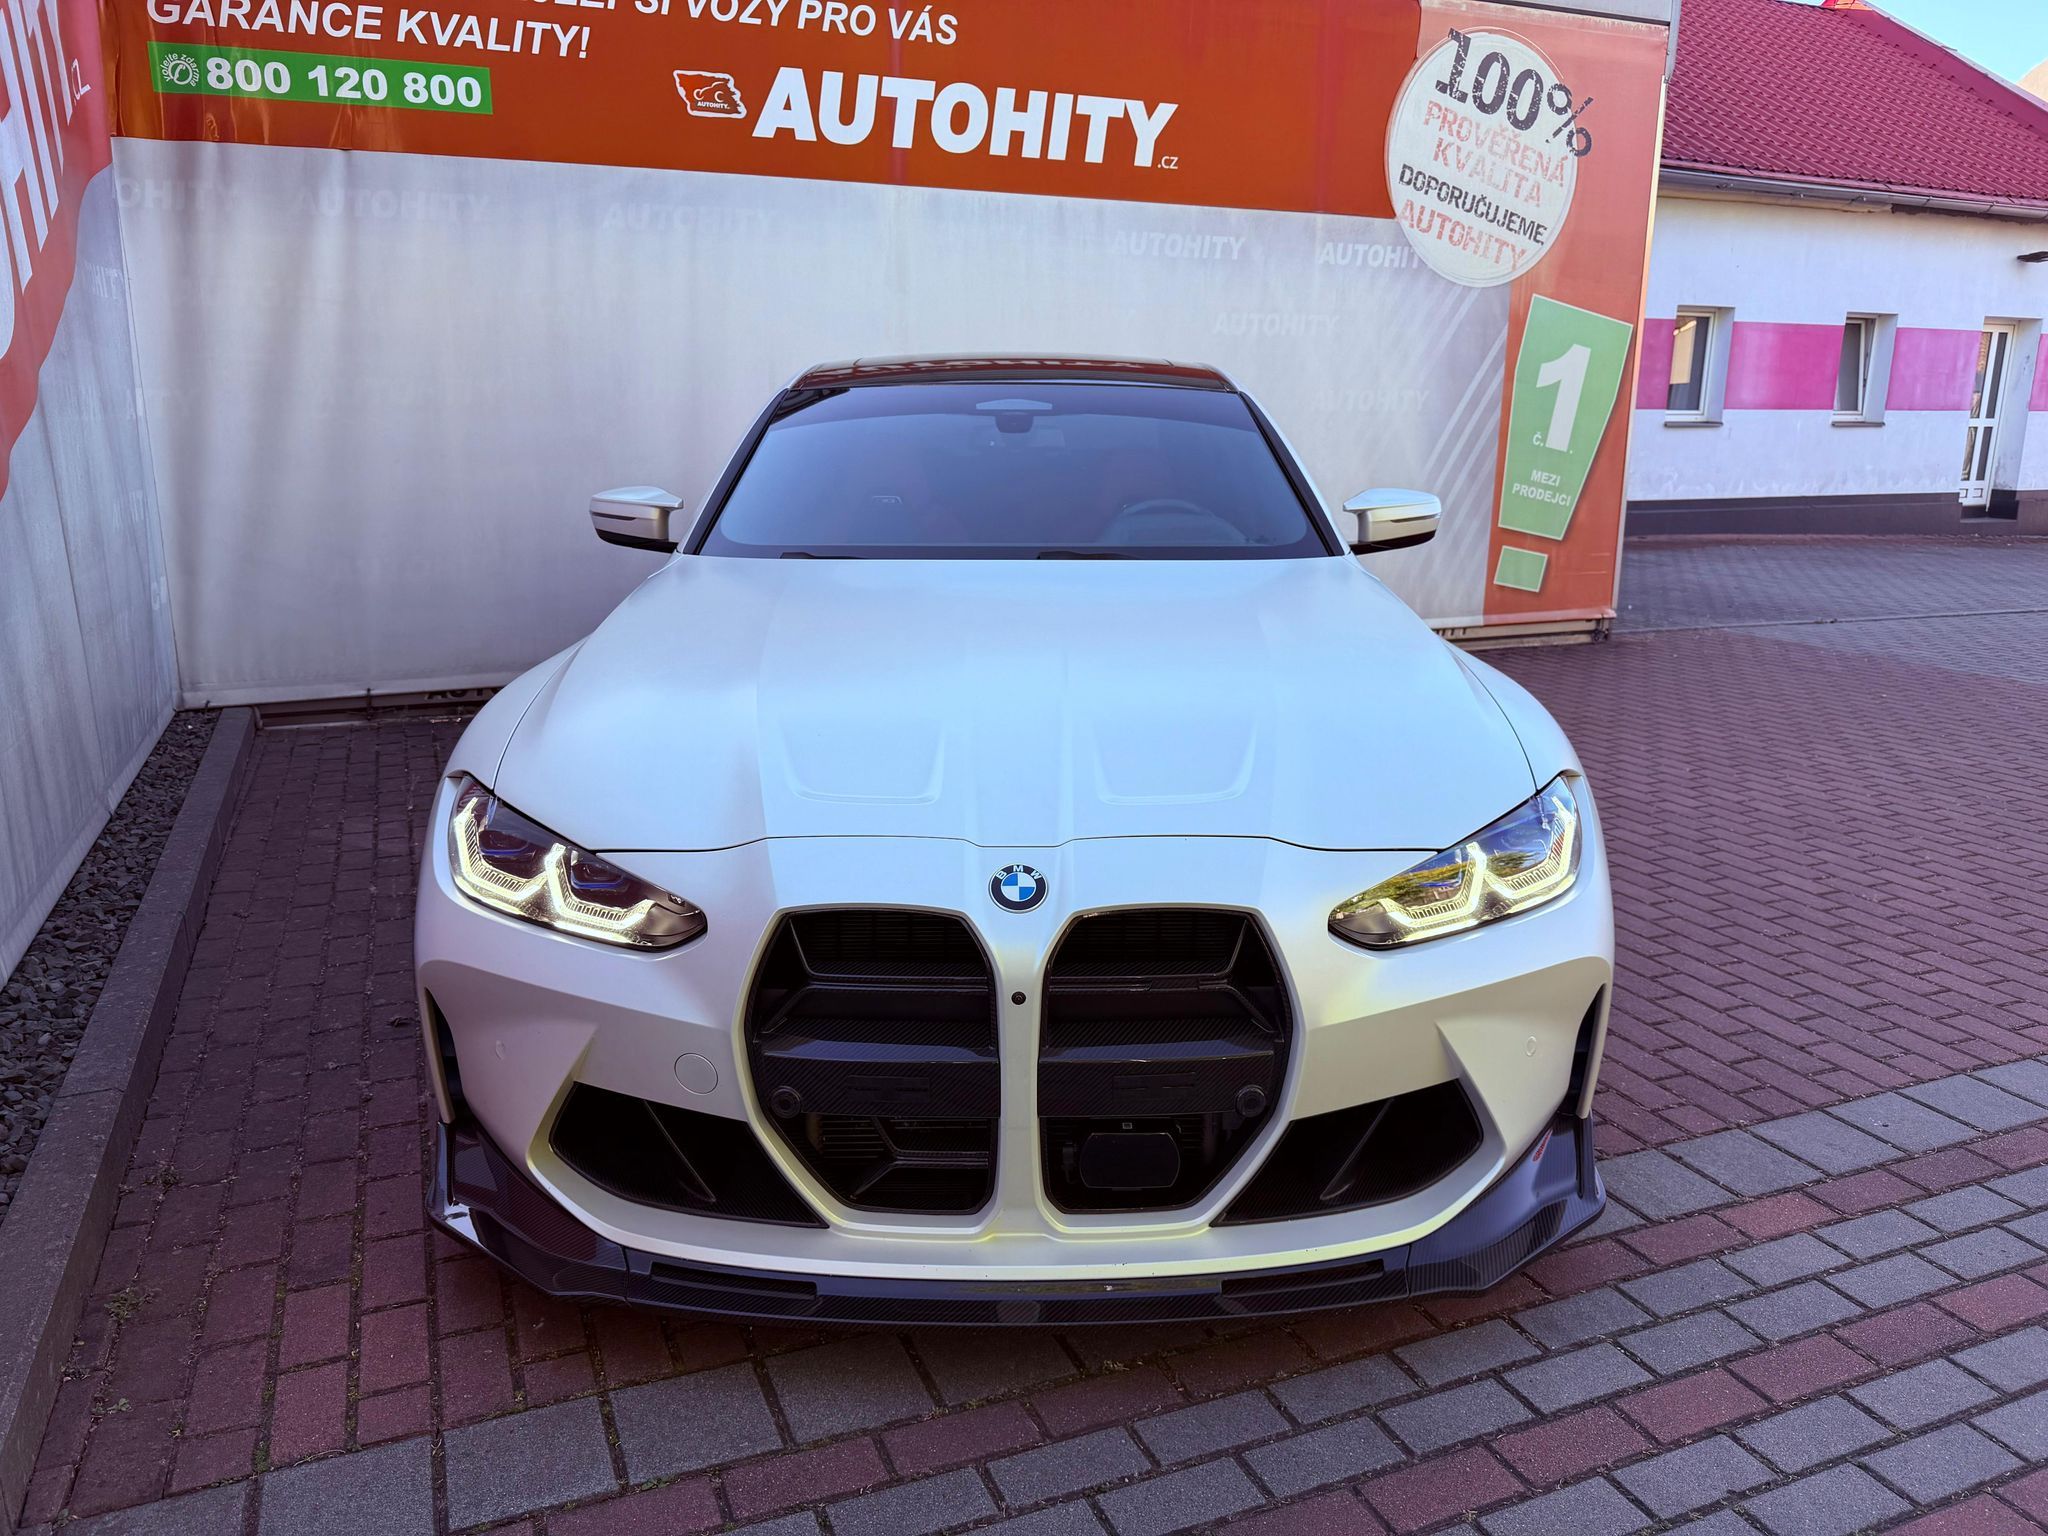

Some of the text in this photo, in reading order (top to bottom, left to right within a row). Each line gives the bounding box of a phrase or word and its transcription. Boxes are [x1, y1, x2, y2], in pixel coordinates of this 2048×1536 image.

[147, 0, 591, 59] GARANCE KVALITY!
[797, 0, 877, 36] PRO
[888, 5, 959, 45] VÁS
[206, 57, 482, 108] 800 120 800
[1435, 28, 1594, 157] 100%
[1423, 100, 1568, 188] PROVĚŘENÁ
[1433, 137, 1542, 208] KVALITA
[1399, 163, 1549, 246] DOPORUČUJEME
[1401, 198, 1526, 272] AUTOHITY
[1512, 483, 1571, 507] PRODEJCI
[1531, 469, 1560, 488] MEZI
[995, 864, 1042, 880] BMW
